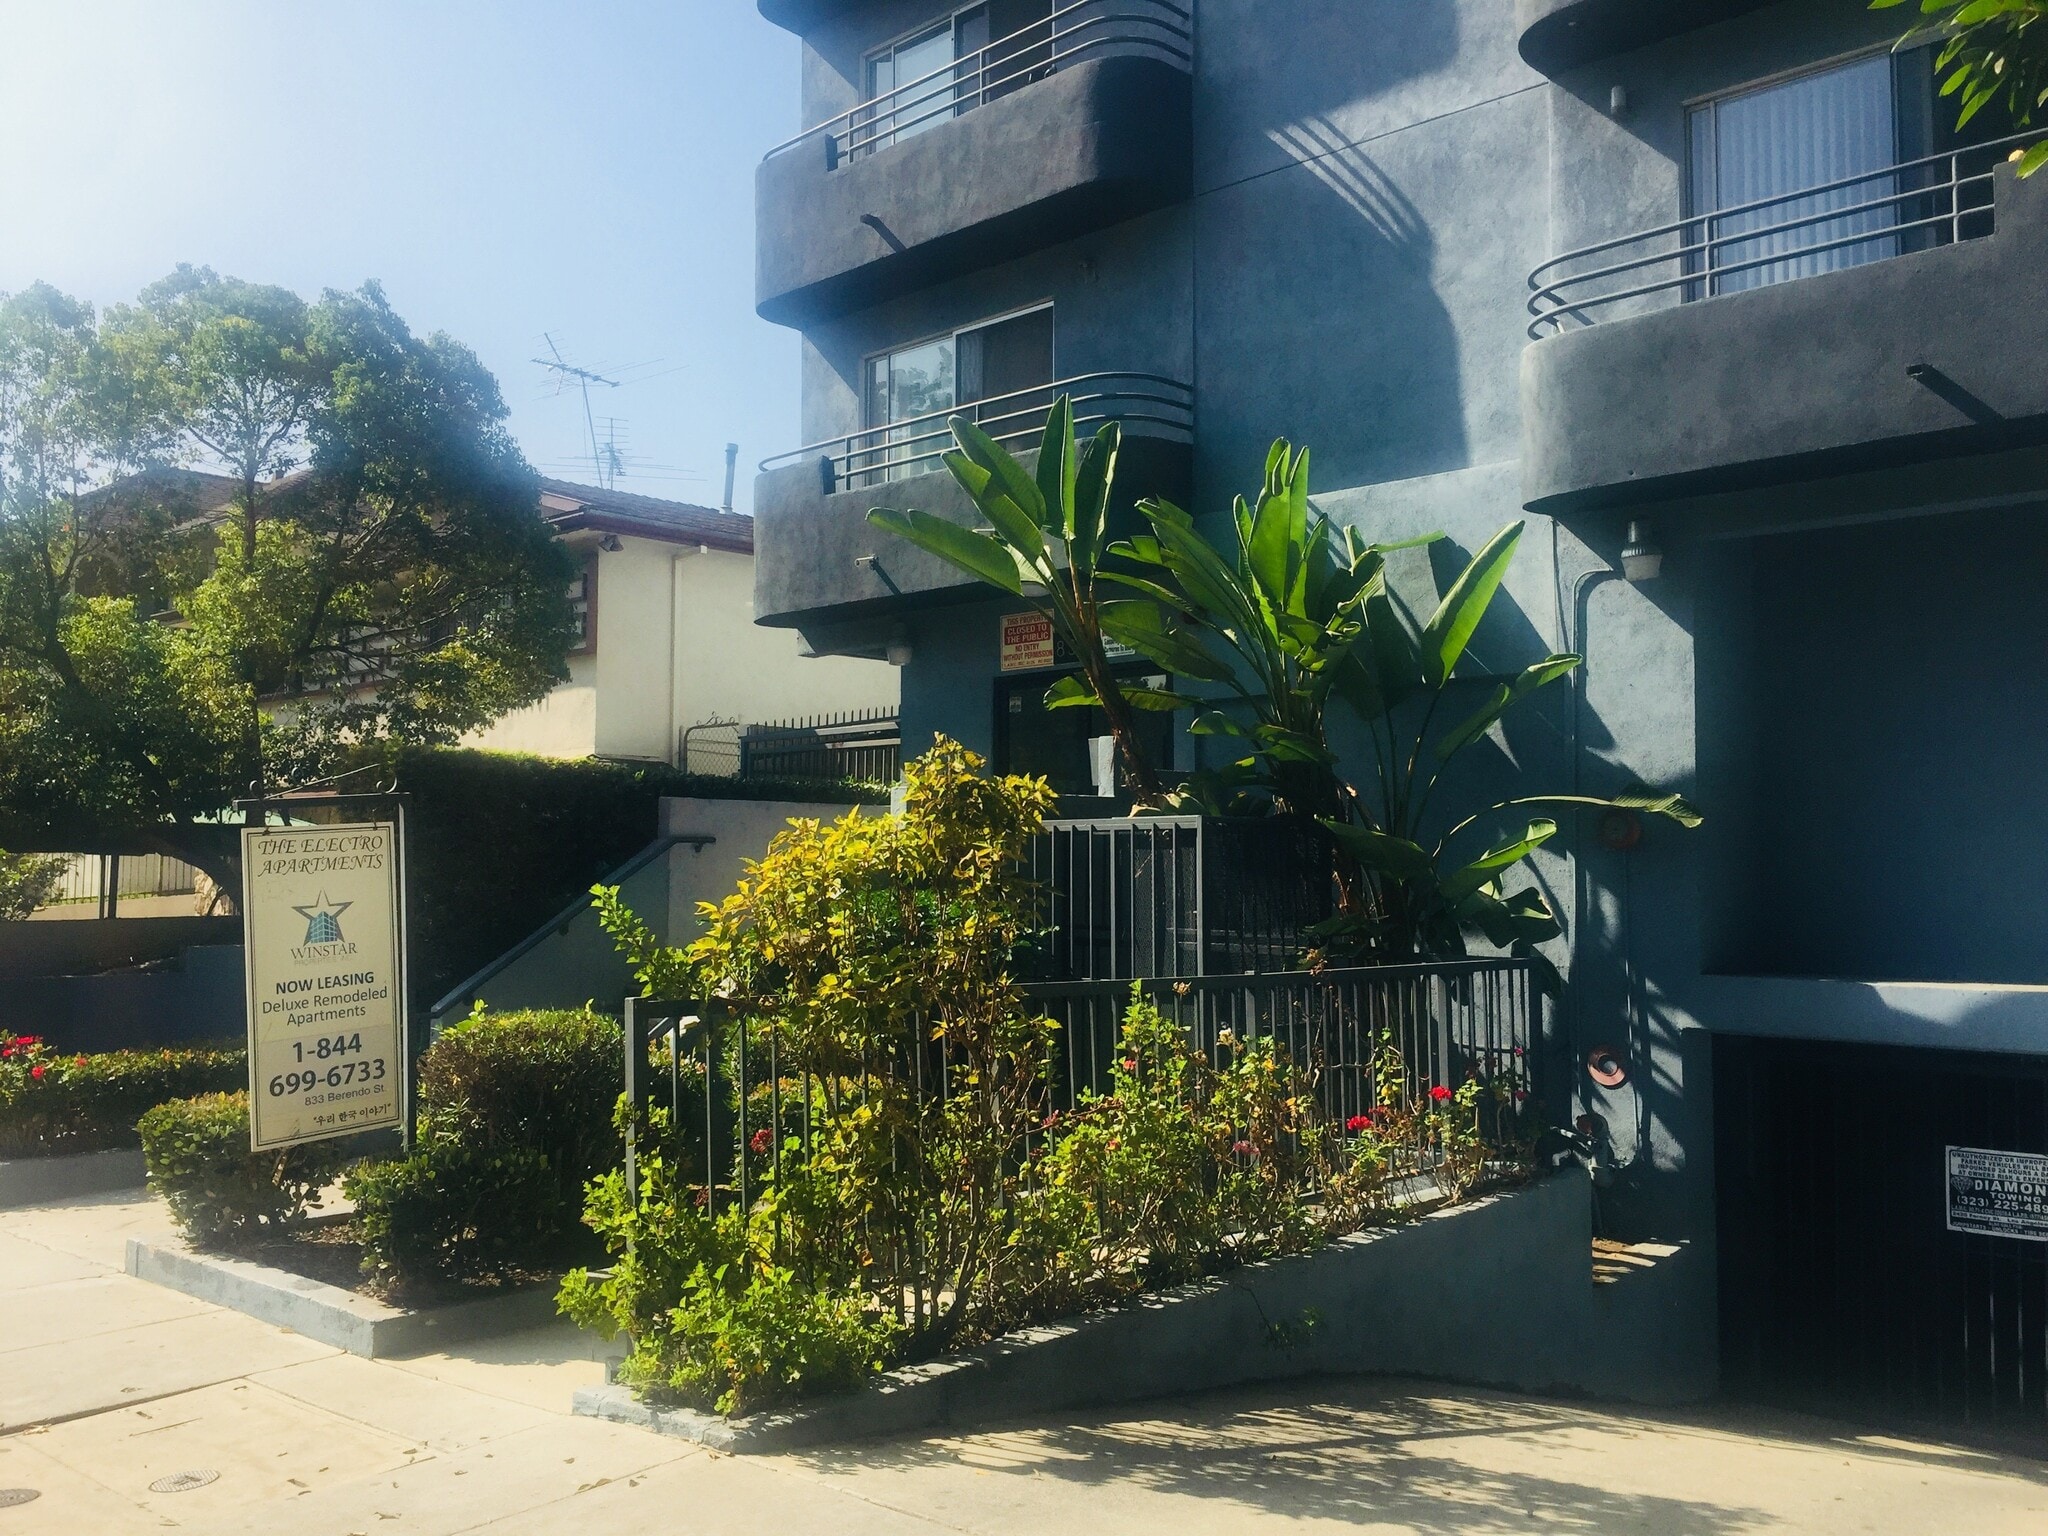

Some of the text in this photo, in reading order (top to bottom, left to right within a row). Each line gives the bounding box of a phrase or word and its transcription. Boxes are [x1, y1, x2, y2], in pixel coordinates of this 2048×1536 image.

[1007, 632, 1048, 644] THE PUBLIC
[1008, 625, 1035, 635] CLOSED
[1024, 643, 1039, 651] ENTRY
[258, 835, 383, 855] THE ELECTRO
[258, 854, 384, 877] APARTMENTS
[290, 942, 358, 960] WINSTAR
[276, 971, 374, 994] NOW LEASING
[262, 986, 388, 1014] Deluxe Remodeled
[287, 1005, 366, 1027] Apartments
[292, 1033, 362, 1063] 1-844
[269, 1058, 386, 1097] 699-6733
[304, 1094, 325, 1106] 833
[328, 1087, 371, 1102] Berendo
[339, 1110, 357, 1122] 한국
[1952, 1152, 2002, 1162] UNAUTHORIZED
[1958, 1164, 1996, 1173] IMPOUNDED
[1975, 1180, 2047, 1197] DIAMON
[1957, 1196, 1989, 1207] (323)
[1994, 1200, 2048, 1213] 225-489
[1990, 1192, 2042, 1204] TOWING
